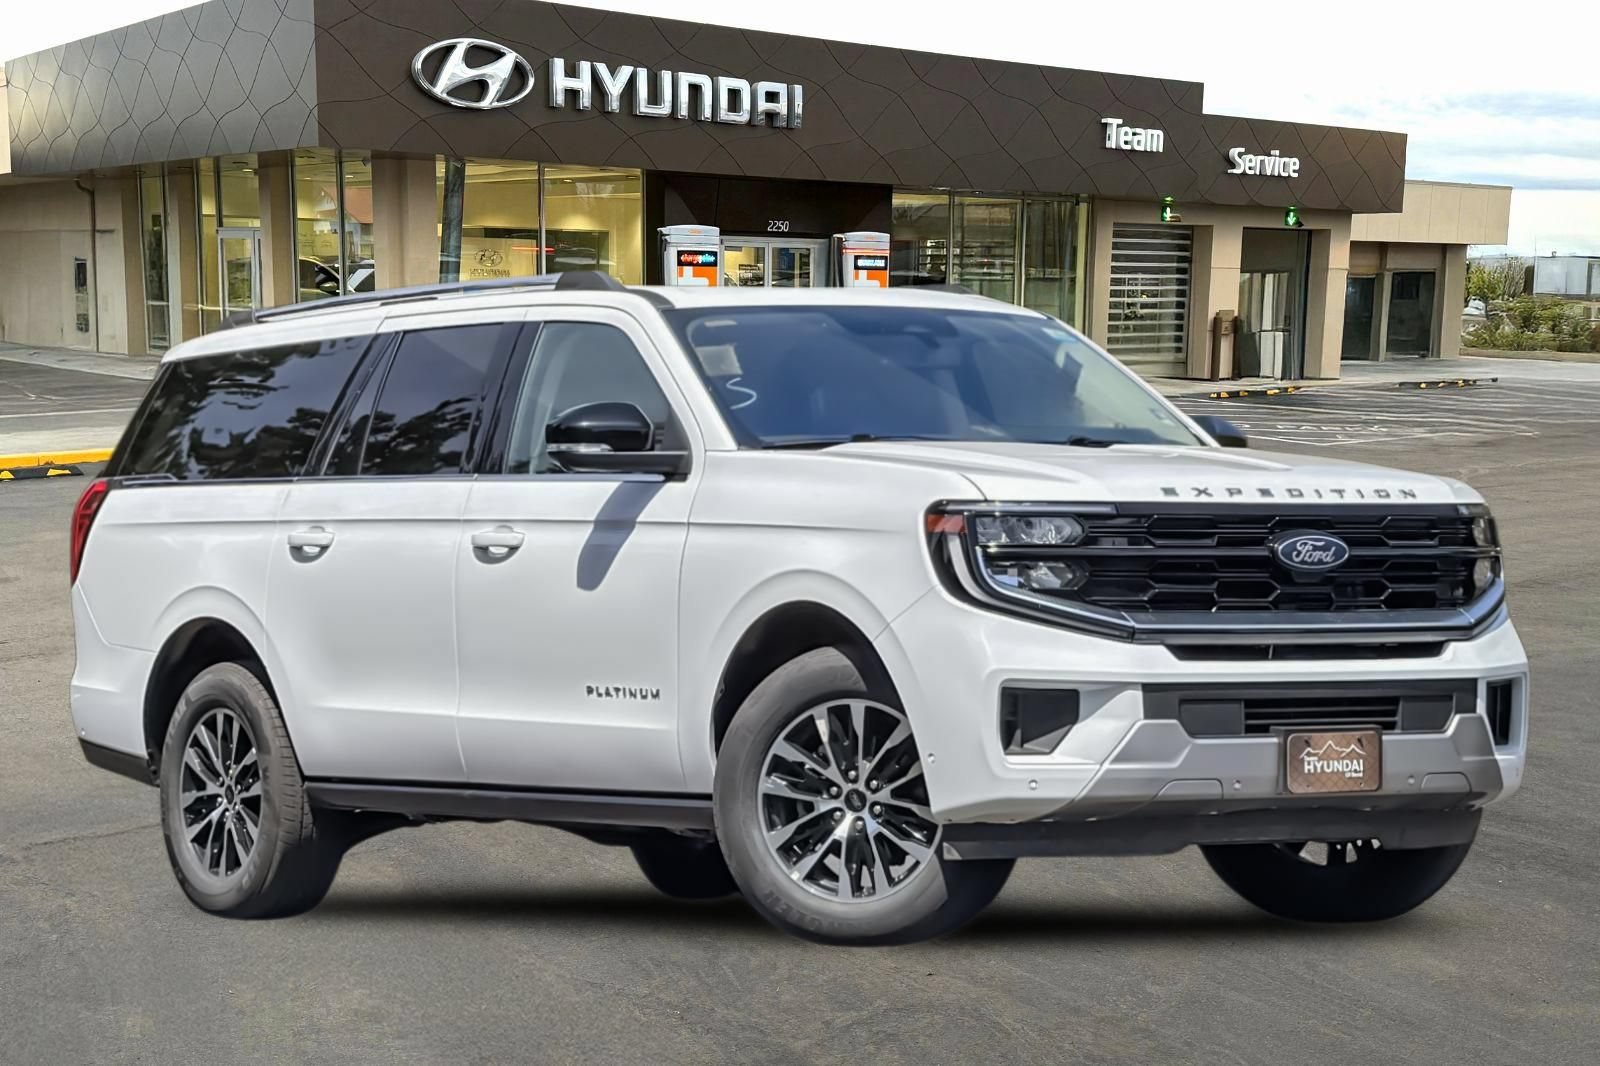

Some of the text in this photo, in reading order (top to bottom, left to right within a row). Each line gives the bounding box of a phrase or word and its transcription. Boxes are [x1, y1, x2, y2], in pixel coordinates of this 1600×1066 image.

[549, 57, 803, 129] HYUNDAI
[1101, 117, 1165, 153] Team
[1227, 147, 1301, 178] Service
[767, 220, 790, 232] 2250
[1160, 487, 1418, 499] EXPEDITION
[1292, 540, 1336, 564] Ford
[585, 685, 660, 700] PLATINUM
[1304, 758, 1364, 774] HYUNDAI
